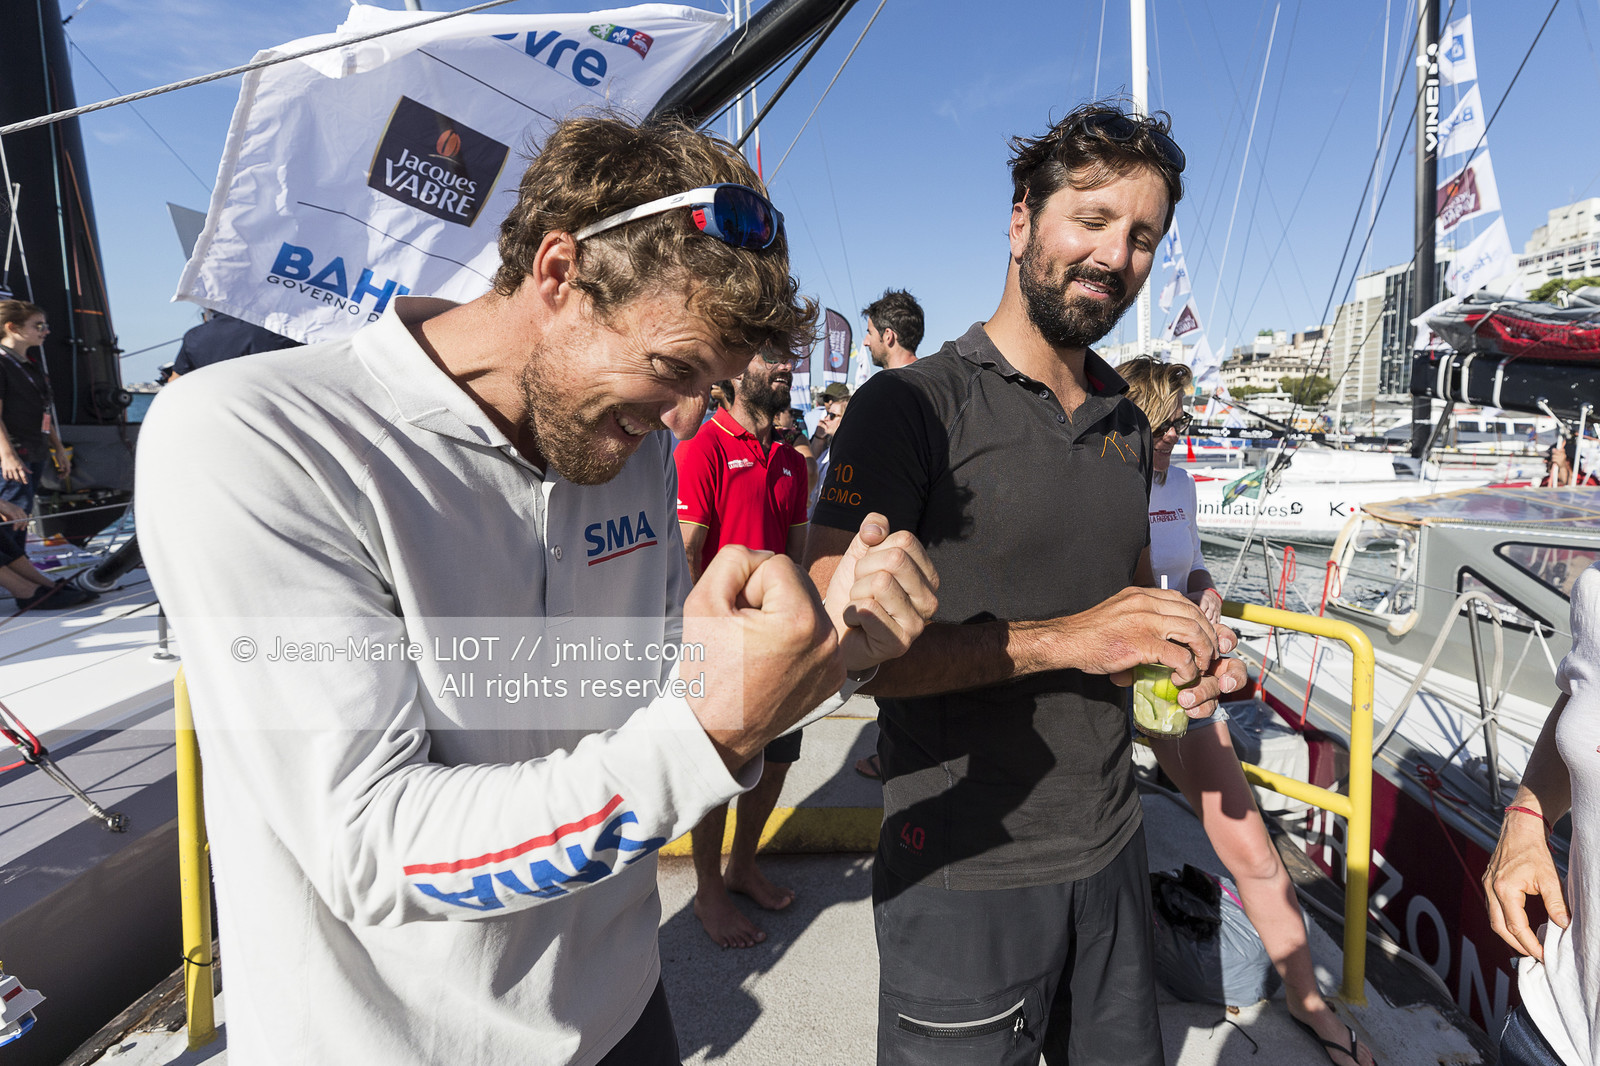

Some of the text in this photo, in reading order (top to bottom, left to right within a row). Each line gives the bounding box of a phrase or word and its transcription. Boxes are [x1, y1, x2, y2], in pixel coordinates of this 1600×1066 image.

[1425, 79, 1440, 152] VINCI
[385, 157, 475, 217] VABRE
[393, 148, 477, 194] Jacques
[267, 275, 360, 315] GOVERNO
[834, 463, 854, 483] 10
[584, 511, 656, 557] SMA
[900, 821, 926, 850] 40
[413, 811, 667, 911] SMA
